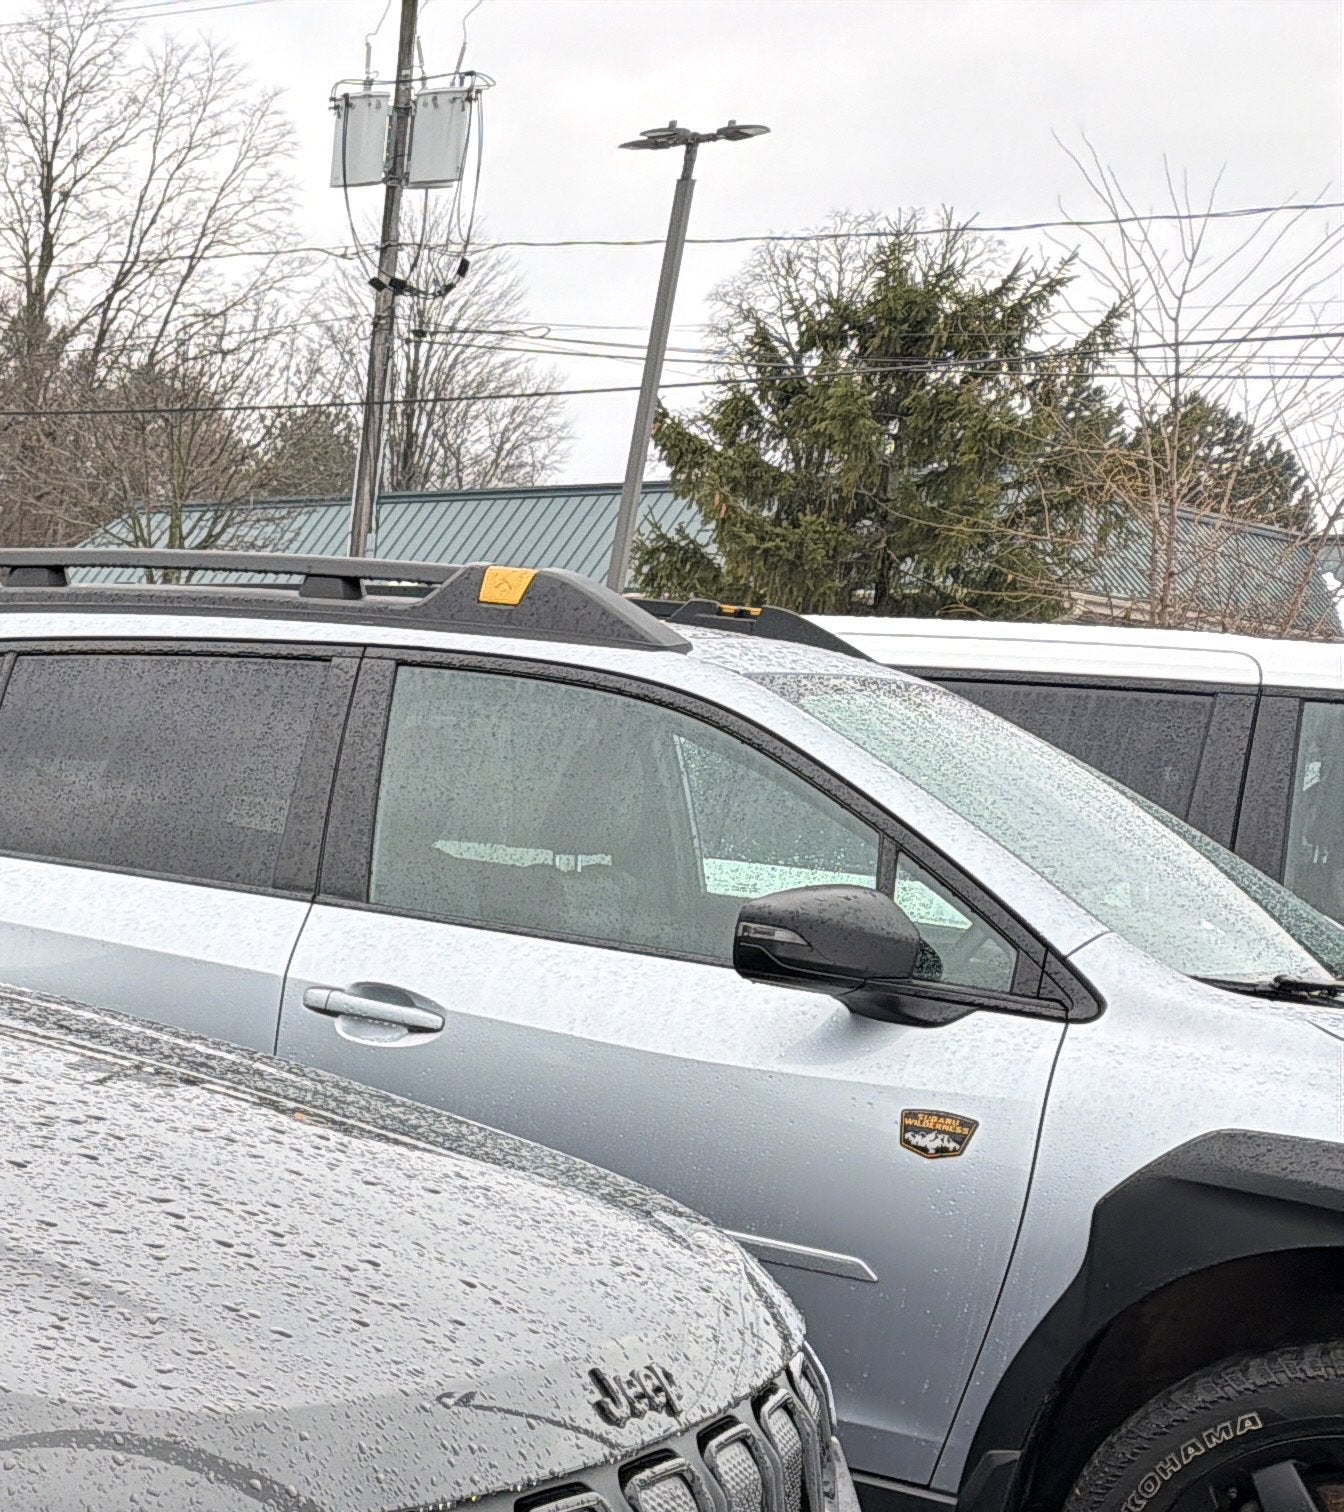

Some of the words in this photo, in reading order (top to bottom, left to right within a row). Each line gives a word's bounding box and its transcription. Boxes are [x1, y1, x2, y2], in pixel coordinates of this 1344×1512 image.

[905, 1117, 970, 1135] WILDERNESS
[918, 1113, 960, 1127] SUBARU
[588, 1362, 683, 1429] Jeep
